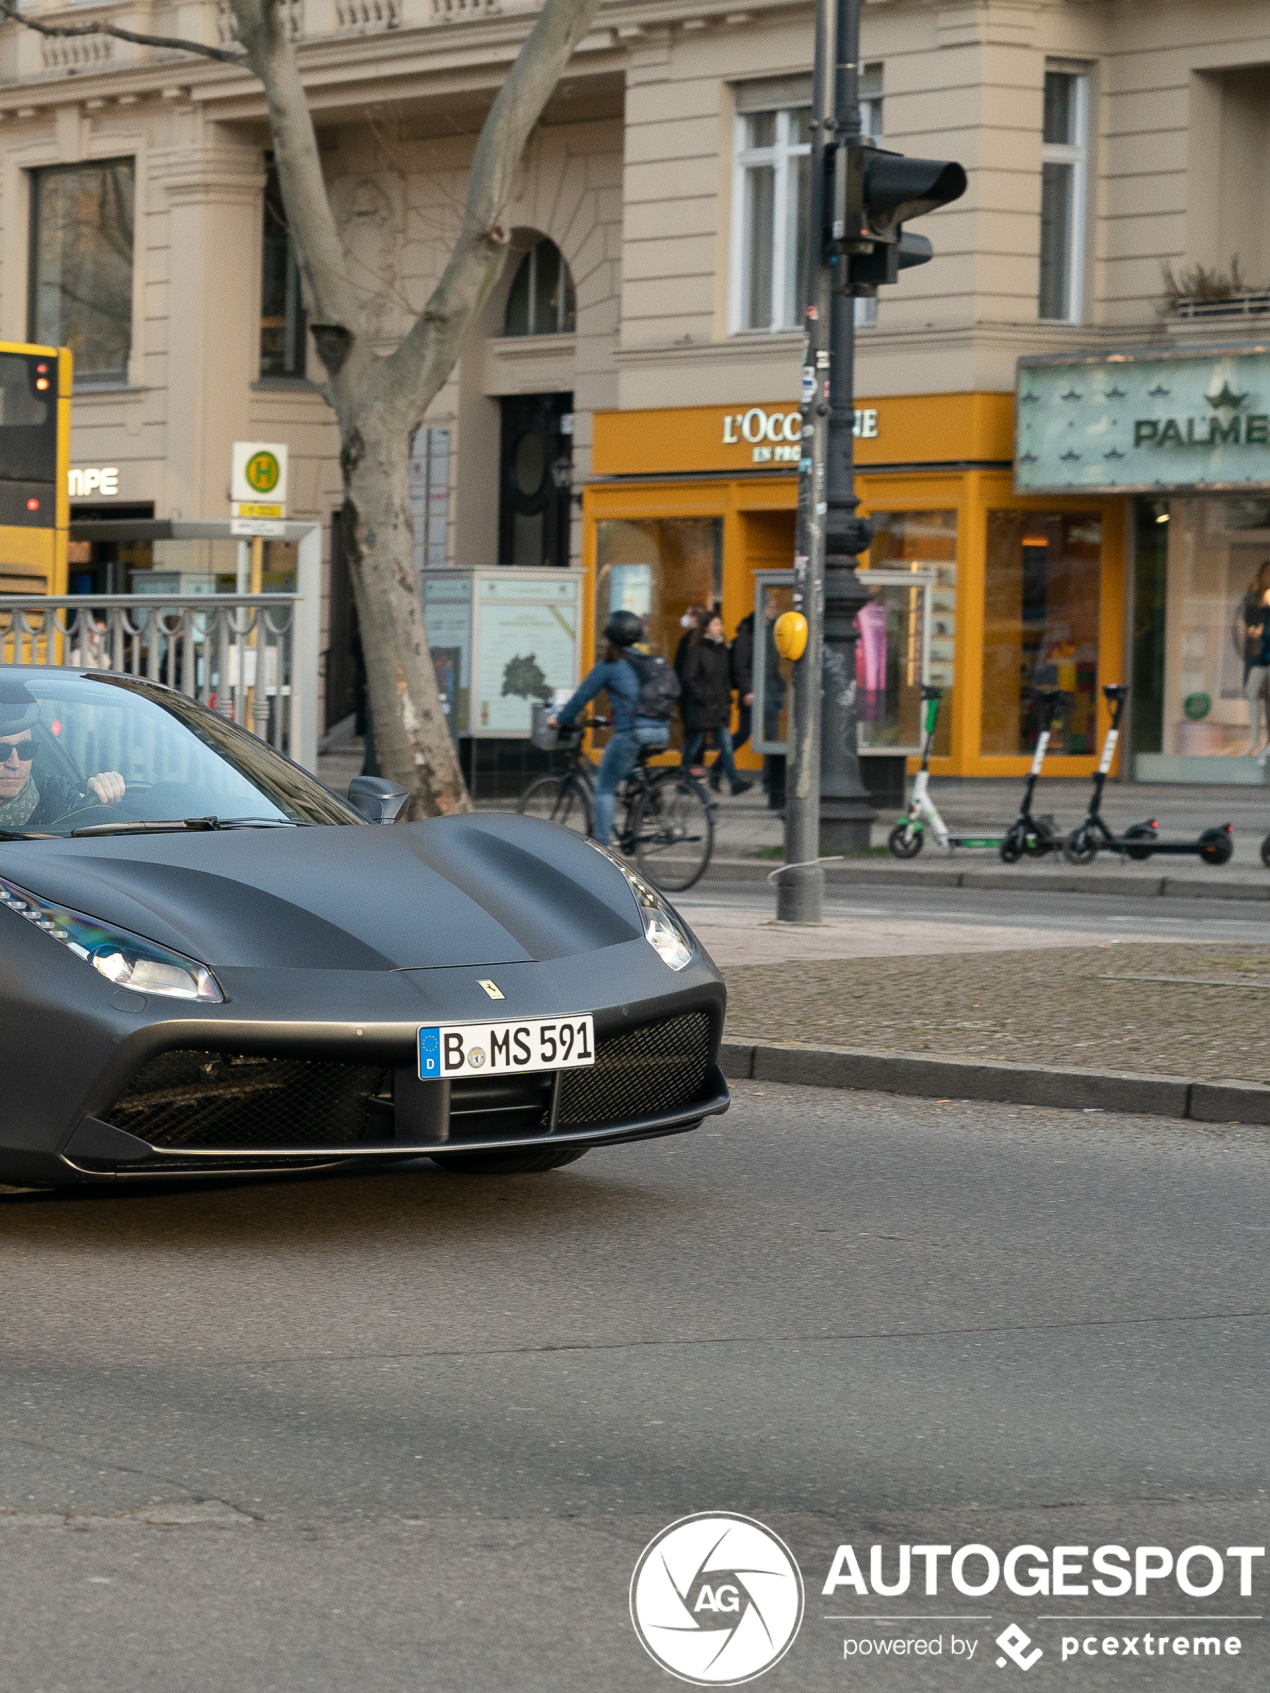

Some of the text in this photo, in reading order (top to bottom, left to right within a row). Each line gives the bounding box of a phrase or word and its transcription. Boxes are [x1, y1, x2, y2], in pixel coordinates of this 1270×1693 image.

[255, 460, 272, 484] H
[444, 1021, 592, 1070] B MS 591
[426, 1058, 436, 1070] D
